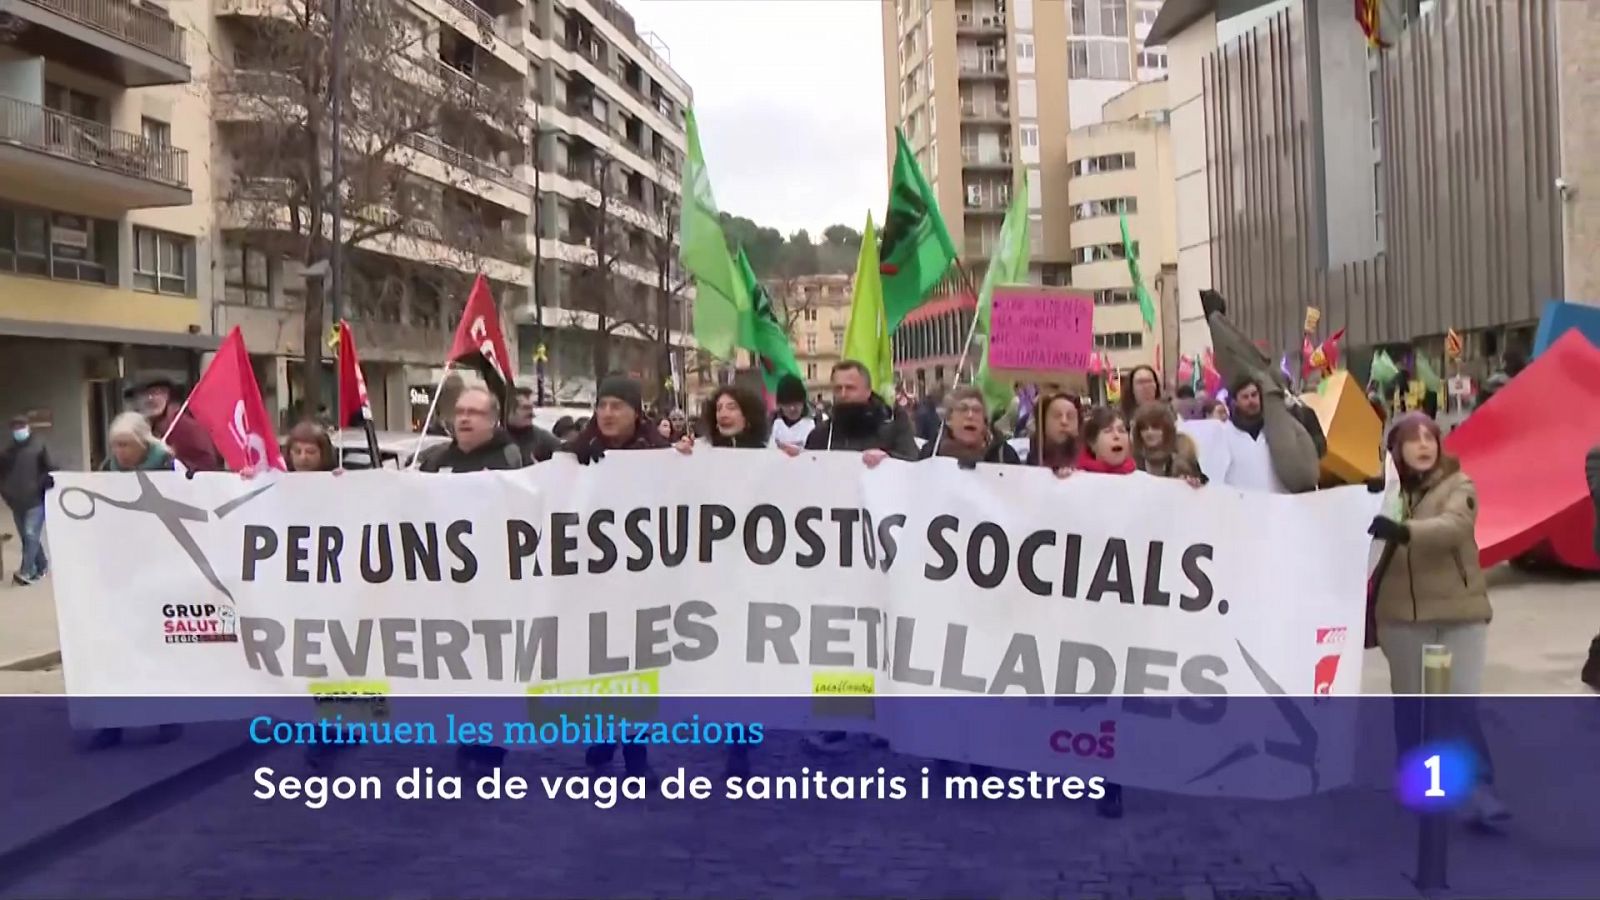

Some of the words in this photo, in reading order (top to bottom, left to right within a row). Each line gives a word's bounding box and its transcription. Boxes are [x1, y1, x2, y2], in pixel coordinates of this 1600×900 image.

[242, 524, 345, 585] PER
[360, 519, 479, 585] UNS
[924, 513, 1230, 616] SOCIALS.
[162, 603, 216, 619] GRUP
[163, 619, 219, 634] SALUT
[588, 600, 720, 675] LES
[746, 600, 1230, 724] RETLLADES
